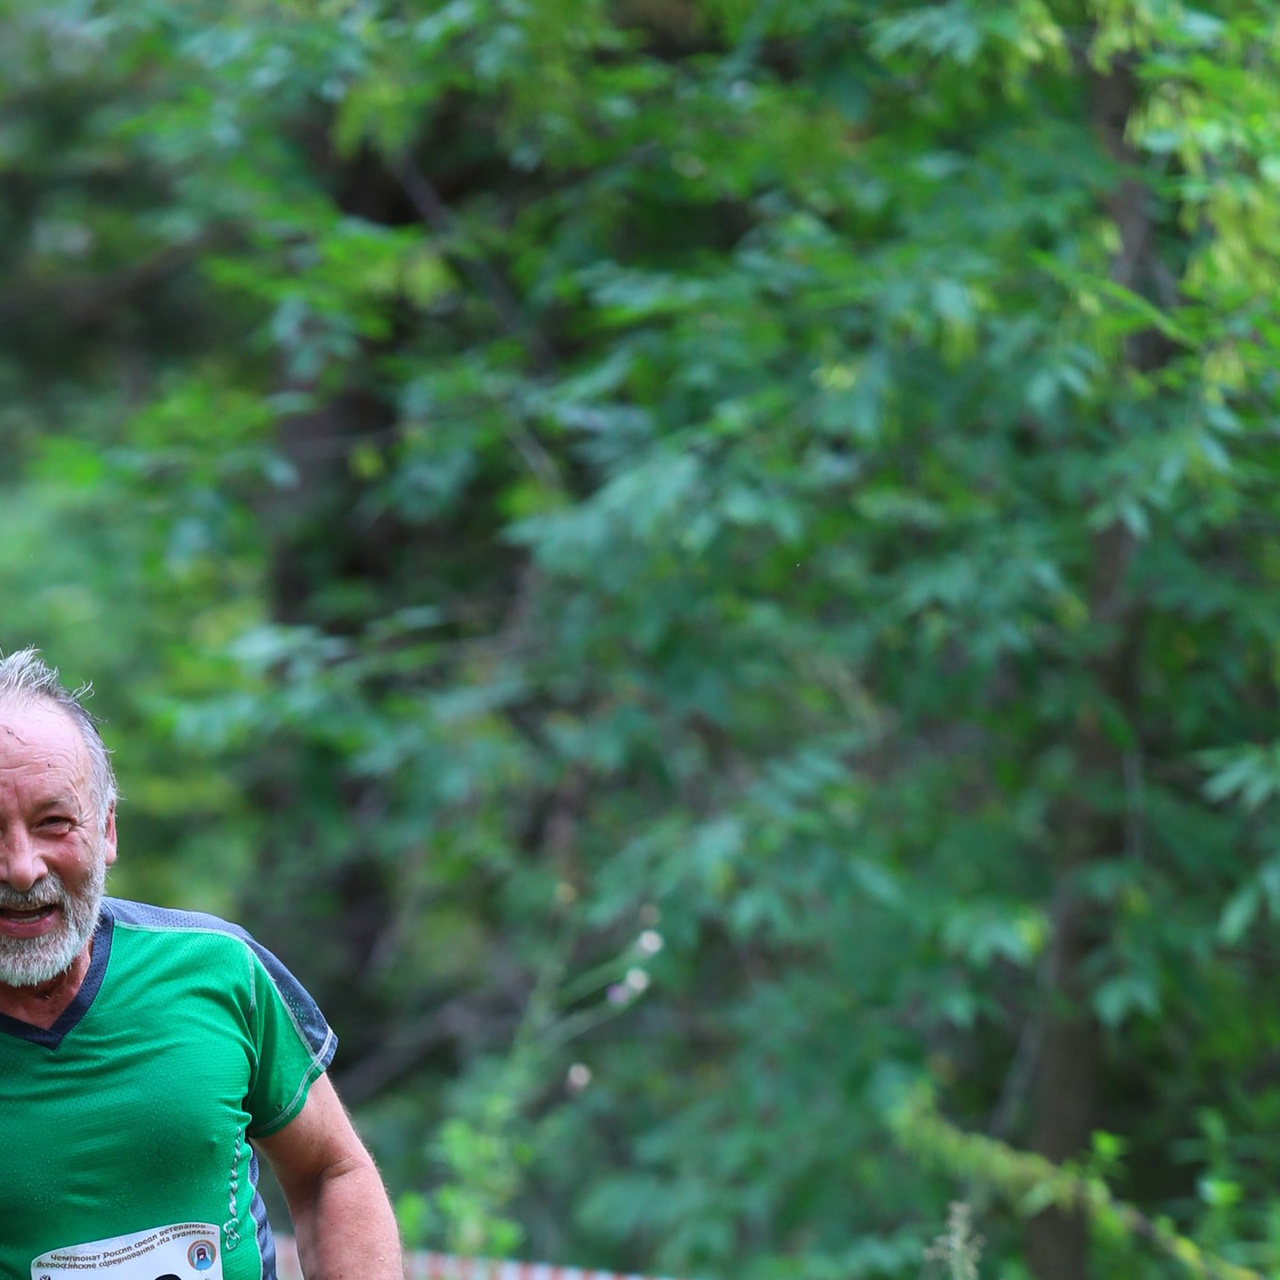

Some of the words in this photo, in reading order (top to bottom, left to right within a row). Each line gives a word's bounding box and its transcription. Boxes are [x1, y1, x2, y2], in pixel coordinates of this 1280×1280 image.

[51, 1254, 101, 1262] Чемпионат
[103, 1246, 132, 1259] России
[134, 1234, 158, 1248] среди
[159, 1223, 206, 1236] ветеранов
[99, 1245, 155, 1268] соревнования
